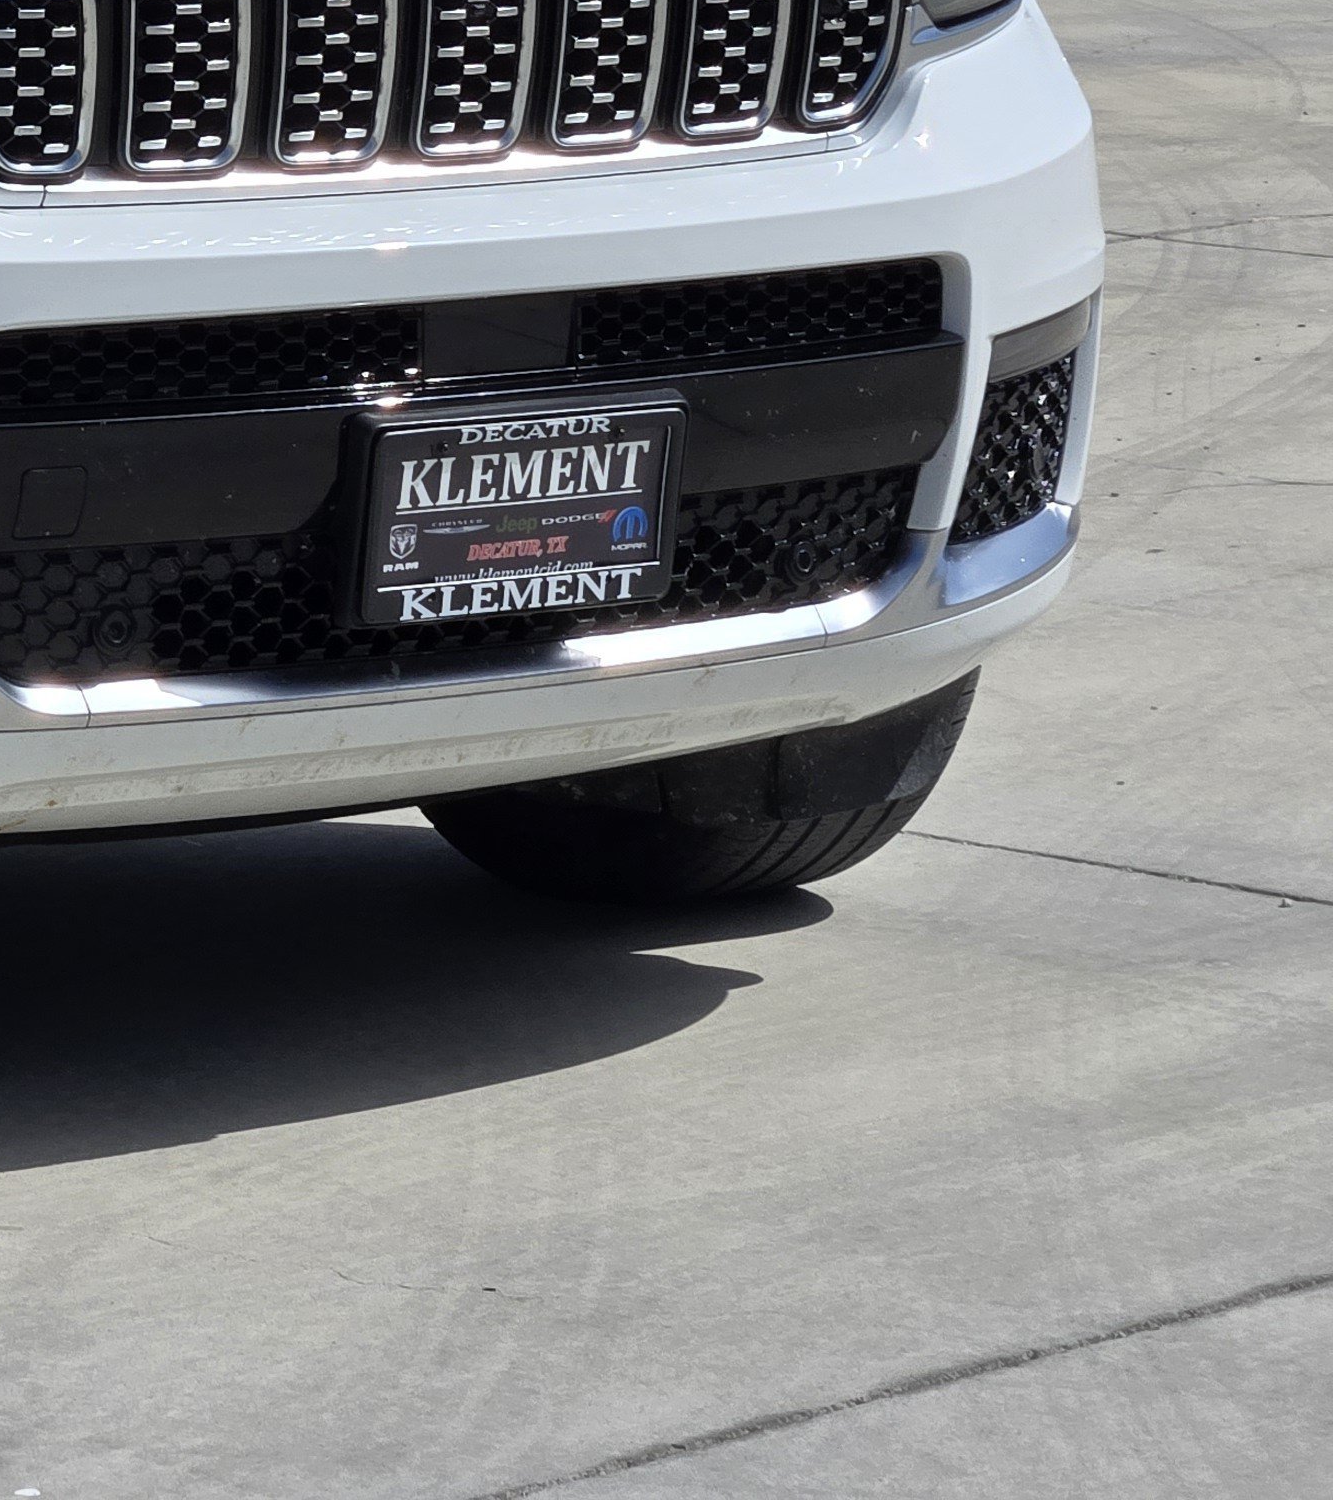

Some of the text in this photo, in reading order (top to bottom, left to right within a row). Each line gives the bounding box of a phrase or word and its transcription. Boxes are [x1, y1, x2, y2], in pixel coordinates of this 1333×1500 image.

[459, 416, 611, 445] DECATUR
[396, 440, 651, 510] KLEMENT
[496, 514, 537, 534] Jeep
[541, 512, 608, 526] DODGE
[466, 535, 569, 562] DECATUR, TX
[611, 542, 647, 552] MOPAR
[383, 561, 420, 573] RAM
[399, 568, 643, 622] KLEMENT
